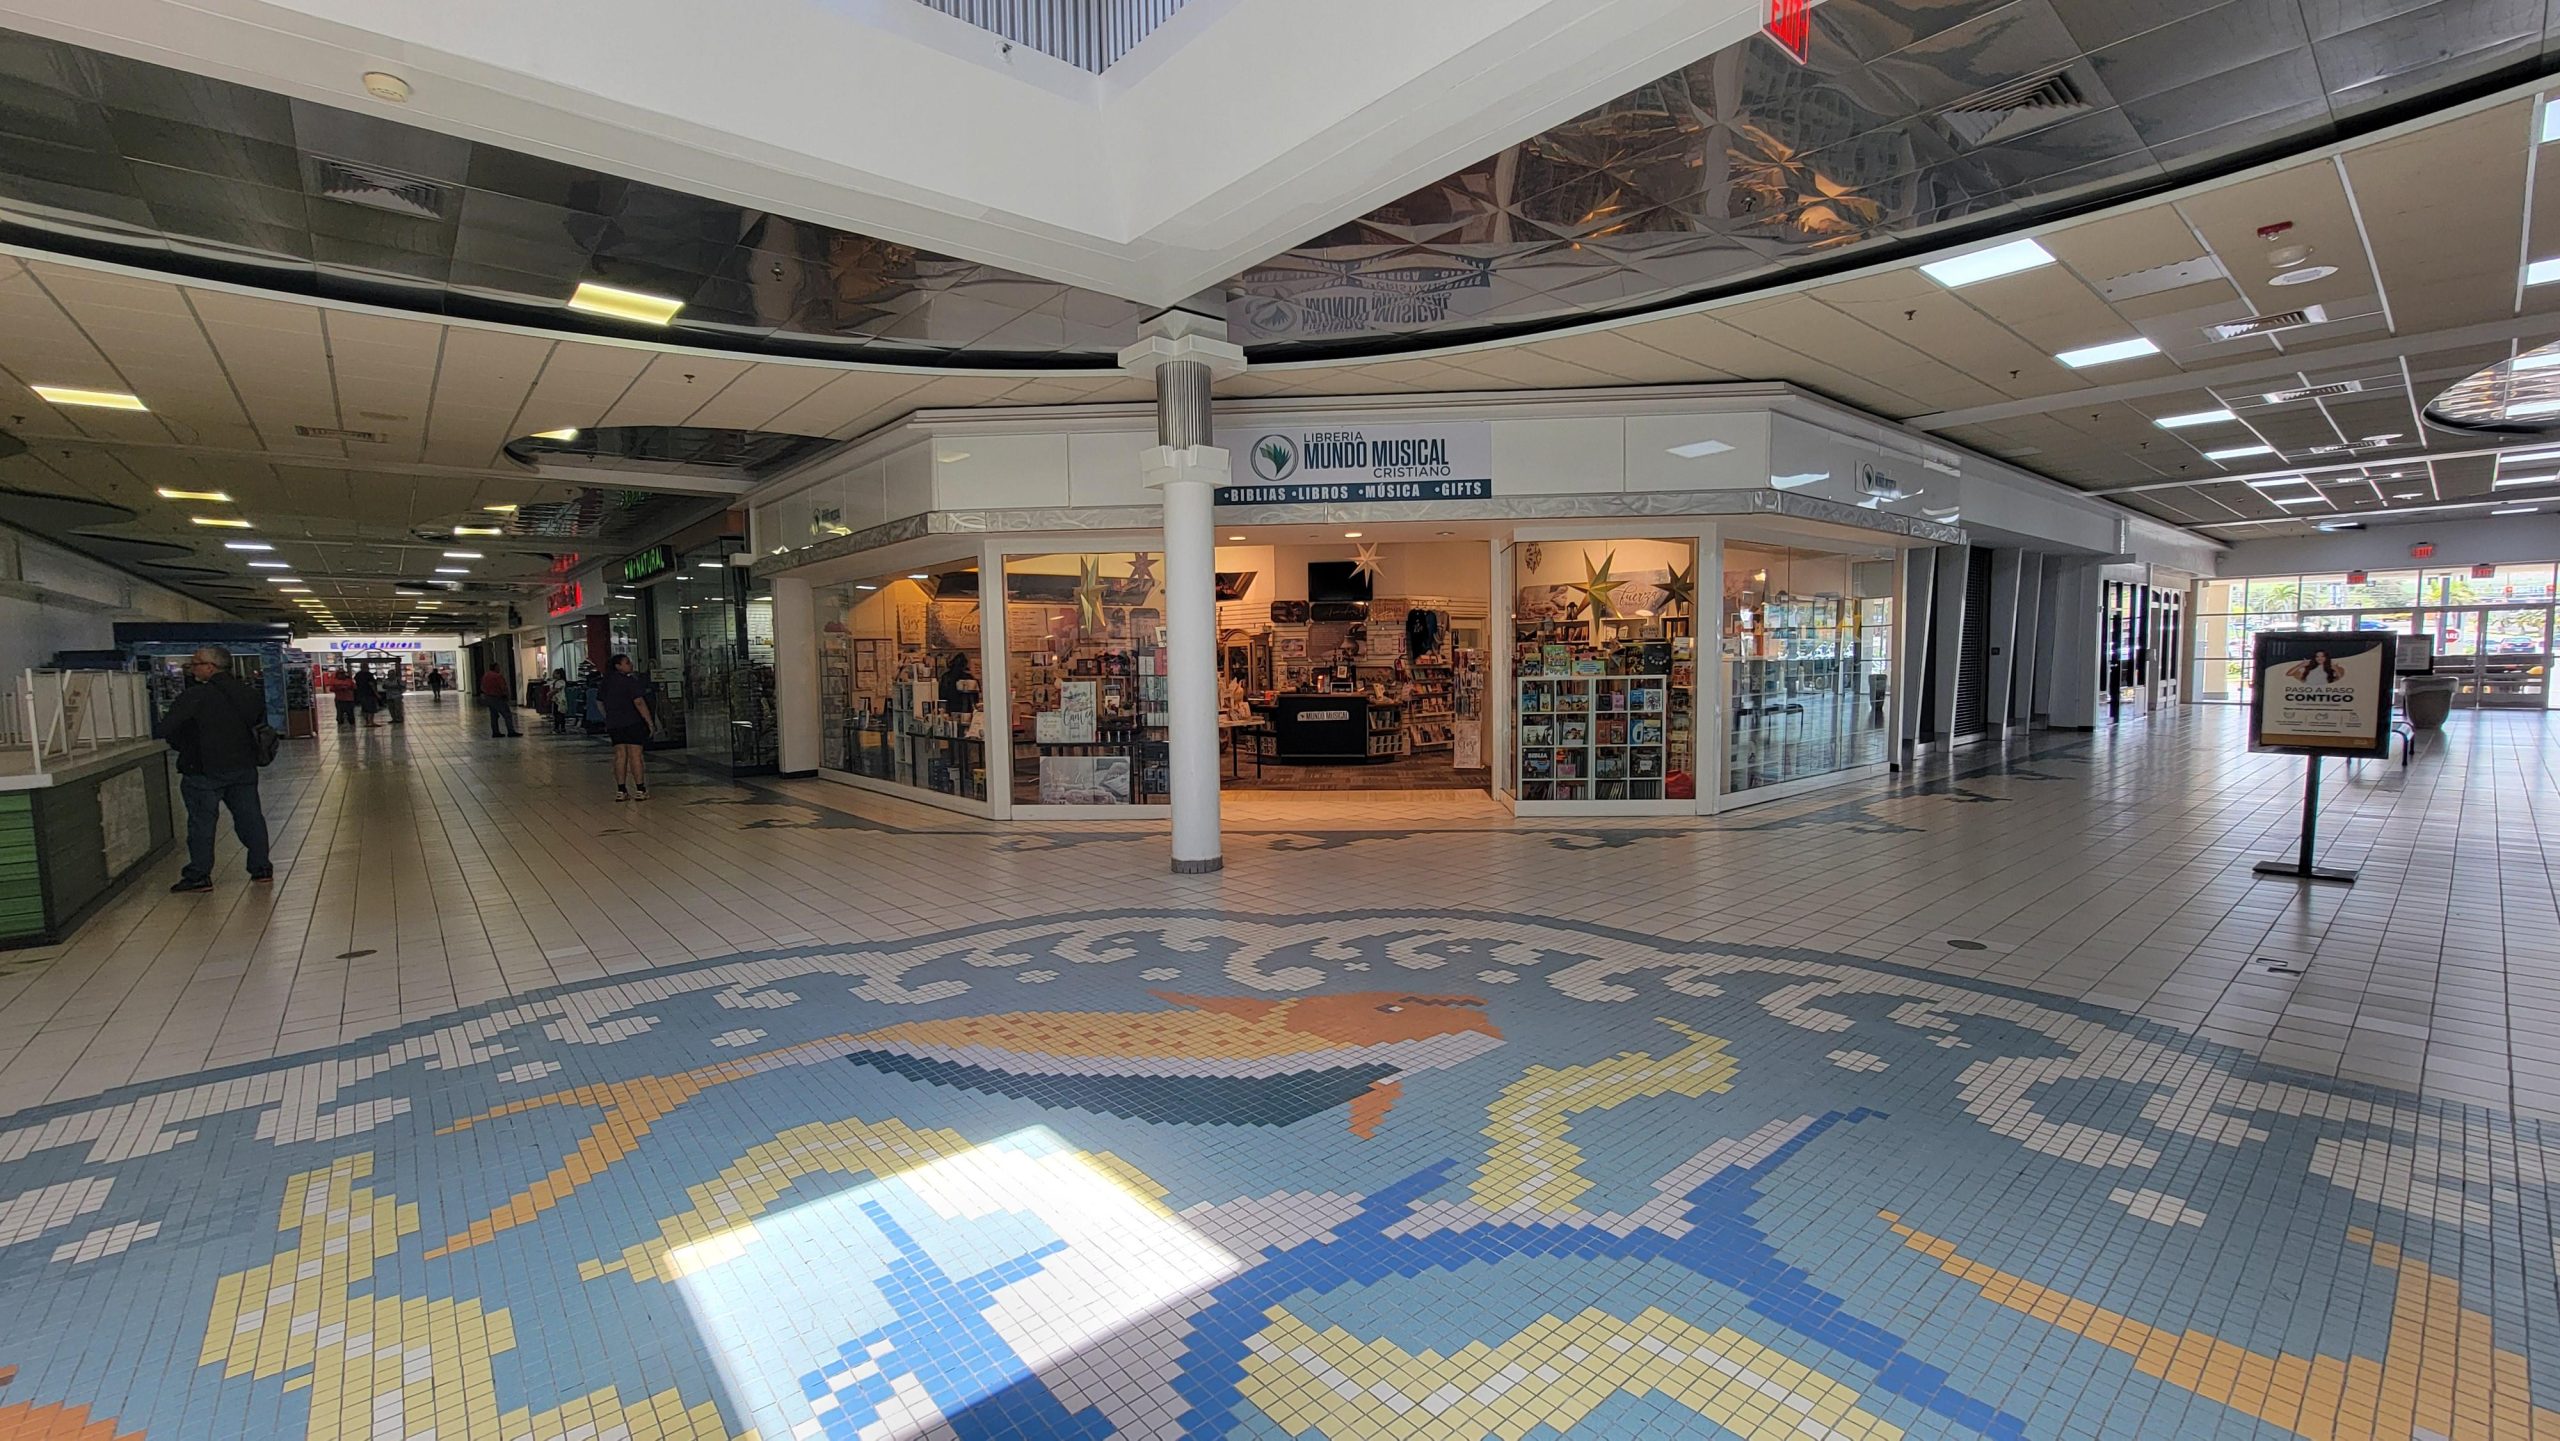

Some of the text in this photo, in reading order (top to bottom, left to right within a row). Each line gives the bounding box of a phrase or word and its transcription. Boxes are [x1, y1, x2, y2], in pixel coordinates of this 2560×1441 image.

[1304, 432, 1363, 443] LIBRERIA
[1304, 439, 1449, 469] MUNDO MUSICAL
[1373, 466, 1451, 478] CRISTIANO
[636, 545, 664, 577] NATURAL
[341, 640, 377, 650] Grand
[2285, 693, 2354, 702] CONTIGO
